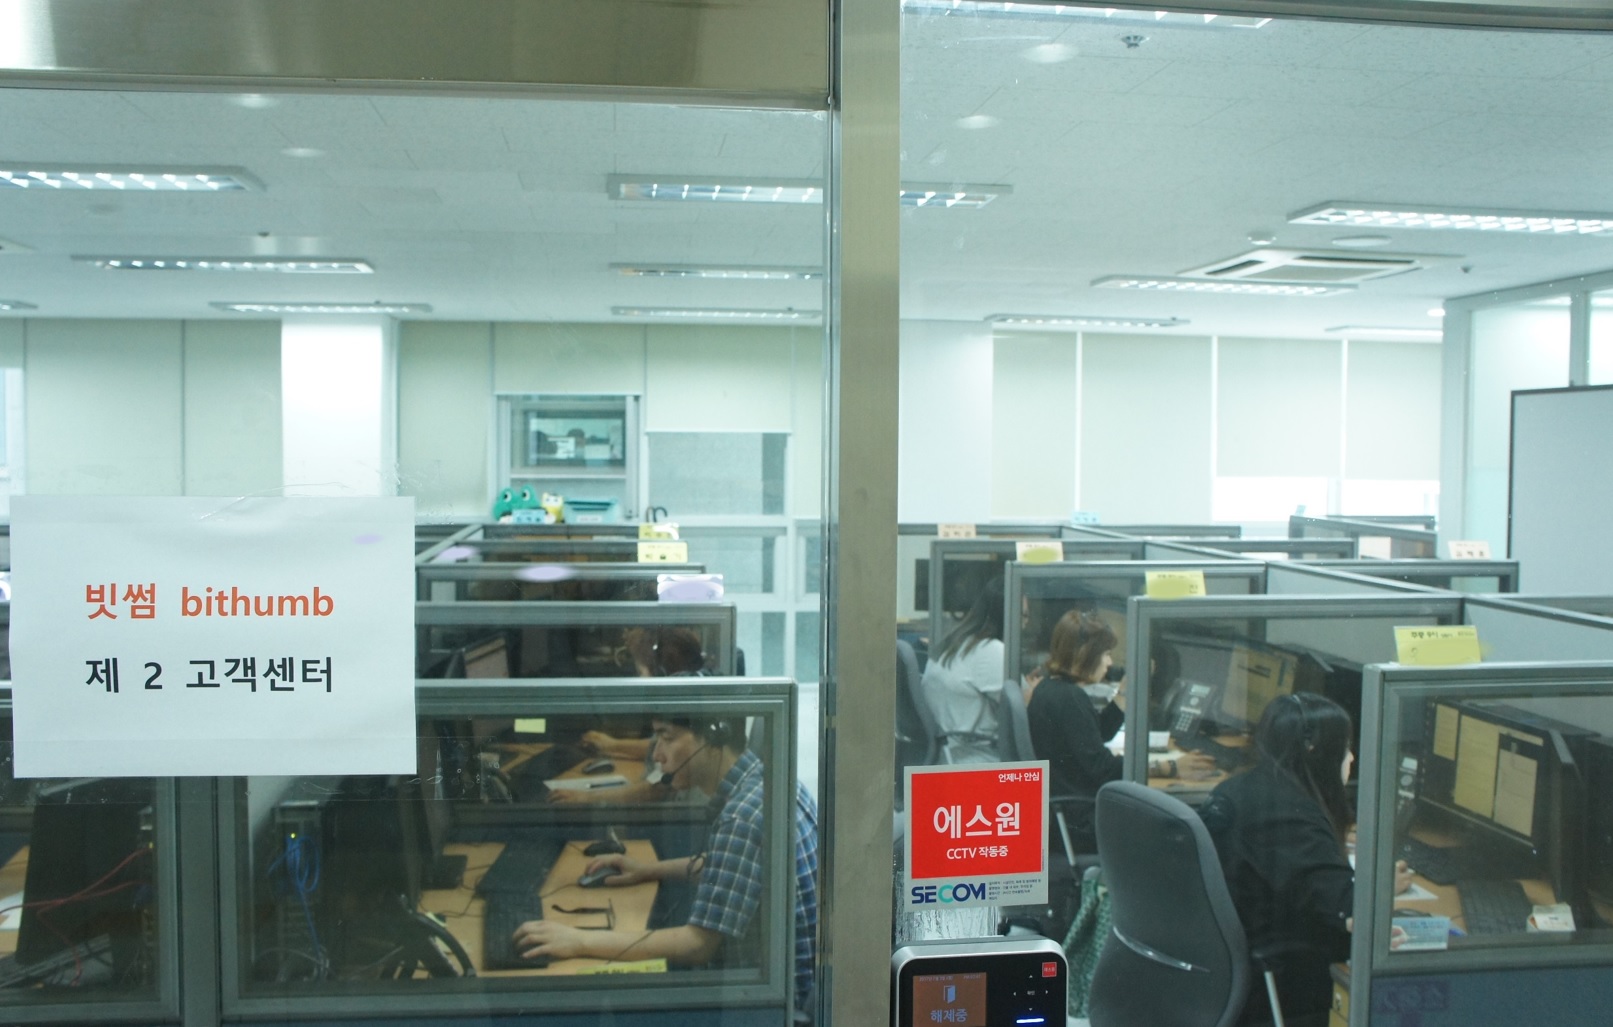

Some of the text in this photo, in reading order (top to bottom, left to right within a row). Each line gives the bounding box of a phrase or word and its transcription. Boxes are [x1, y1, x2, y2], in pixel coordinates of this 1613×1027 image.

[85, 583, 335, 620] 빗썸 bithumb
[85, 656, 333, 693] 제 2 고객센터
[998, 772, 1040, 783] 언제나 안심
[933, 802, 1020, 839] 에스원
[946, 845, 1009, 860] CCTV 작동중
[911, 883, 986, 904] SECOM
[930, 1008, 968, 1023] 해제중
